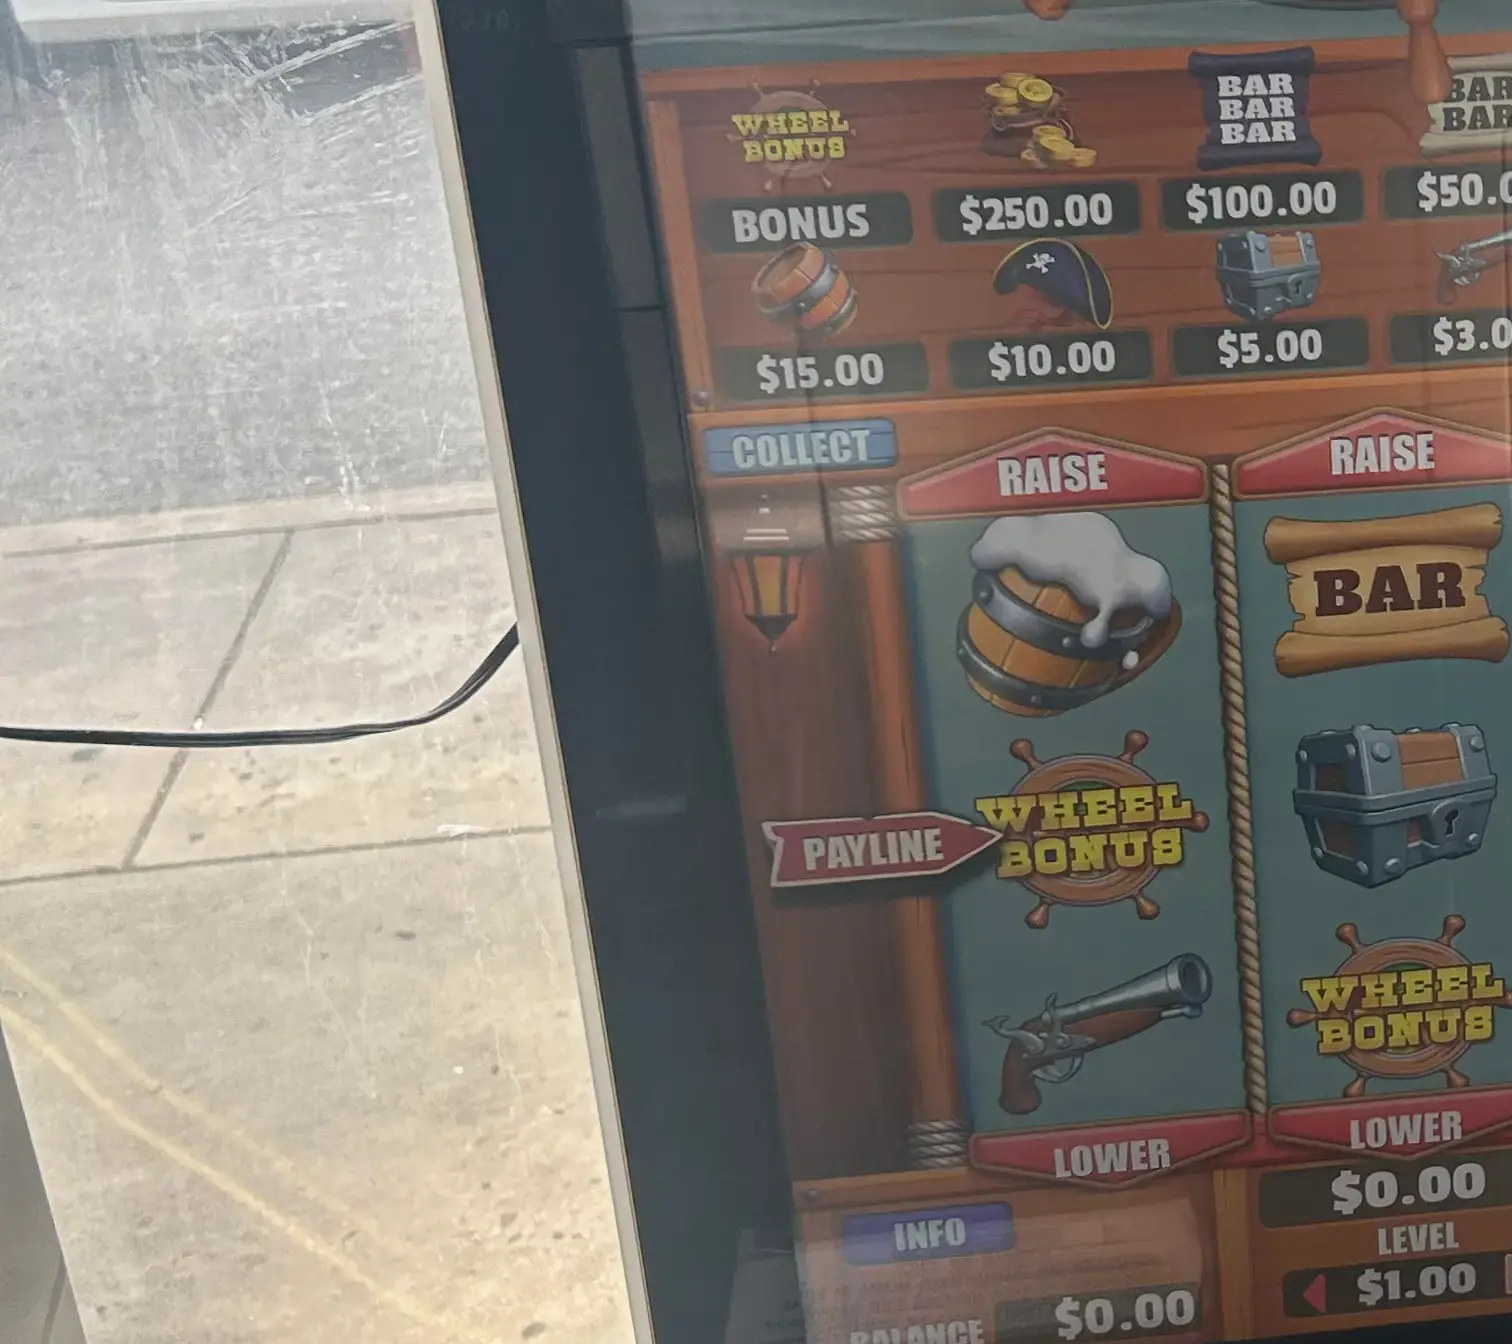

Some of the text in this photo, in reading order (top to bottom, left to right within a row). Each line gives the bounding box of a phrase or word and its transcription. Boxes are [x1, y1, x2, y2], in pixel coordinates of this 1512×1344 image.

[1217, 73, 1294, 97] BAR
[732, 110, 850, 136] WHEEL
[1219, 96, 1295, 121] BAR
[745, 137, 846, 163] BONUS
[1220, 120, 1297, 144] BAR
[960, 193, 1113, 235] $250.00
[1186, 181, 1336, 223] $100.00
[733, 204, 870, 243] BONUS
[988, 340, 1116, 381] $10.00
[1218, 328, 1322, 368] $5.00
[756, 353, 884, 394] $15.00
[733, 430, 870, 469] COLLECT
[1330, 433, 1435, 474] RAISE
[997, 452, 1108, 496] RAISE
[1314, 562, 1465, 616] BAR
[976, 783, 1192, 832] WHEEL
[803, 827, 944, 871] PAYLINE
[997, 828, 1183, 878] BONUS
[1300, 962, 1504, 1012] WHEEL
[1316, 1005, 1495, 1055] BONUS
[1350, 1111, 1462, 1150] LOWER
[1054, 1138, 1171, 1179] LOWER
[1331, 1163, 1486, 1215] $0.00
[894, 1218, 966, 1251] INFO
[1377, 1221, 1459, 1256] LEVEL
[1357, 1262, 1476, 1306] $1.00
[1054, 1290, 1195, 1341] $0.00
